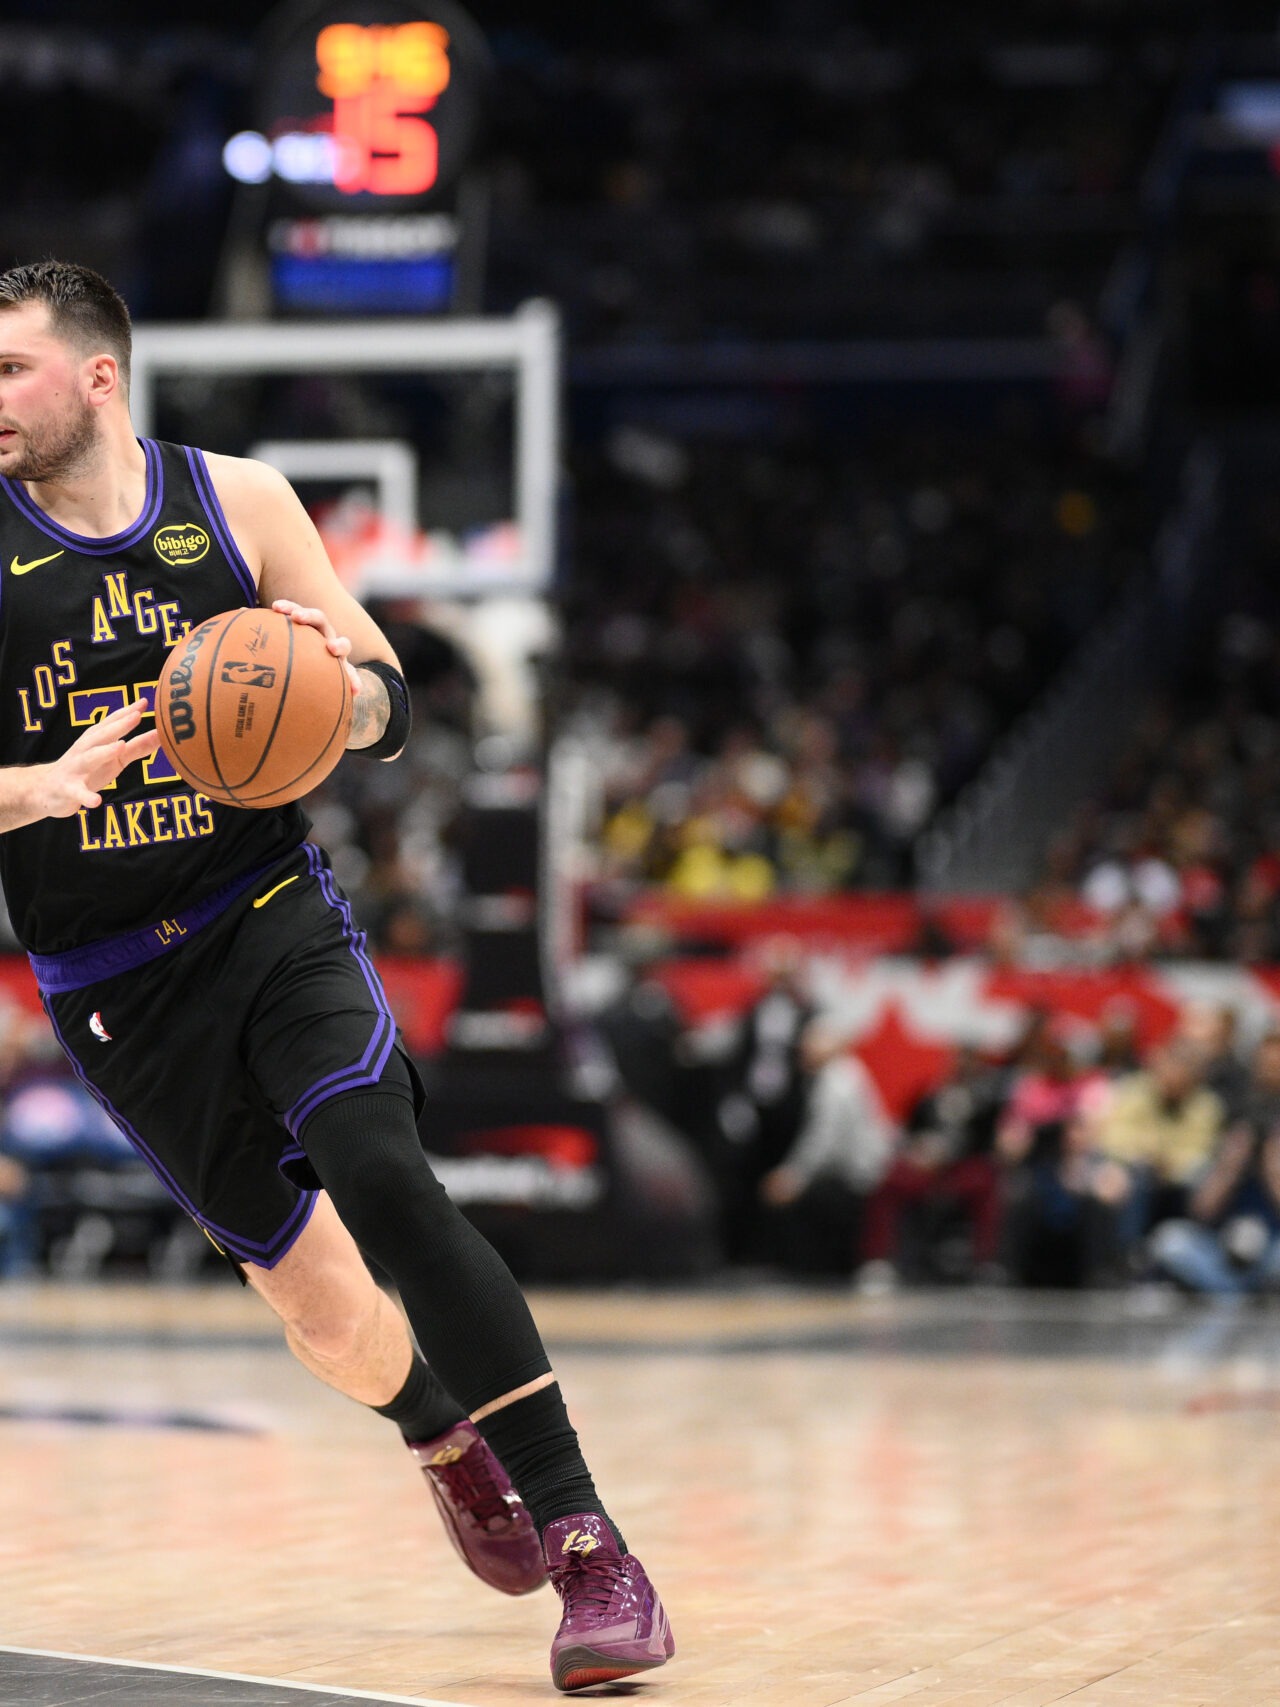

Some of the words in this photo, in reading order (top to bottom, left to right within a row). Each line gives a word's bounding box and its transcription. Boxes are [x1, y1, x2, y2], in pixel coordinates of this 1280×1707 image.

[157, 534, 206, 551] bibigo
[17, 638, 78, 732] LOS
[77, 791, 216, 852] LAKERS
[154, 918, 188, 945] LAL
